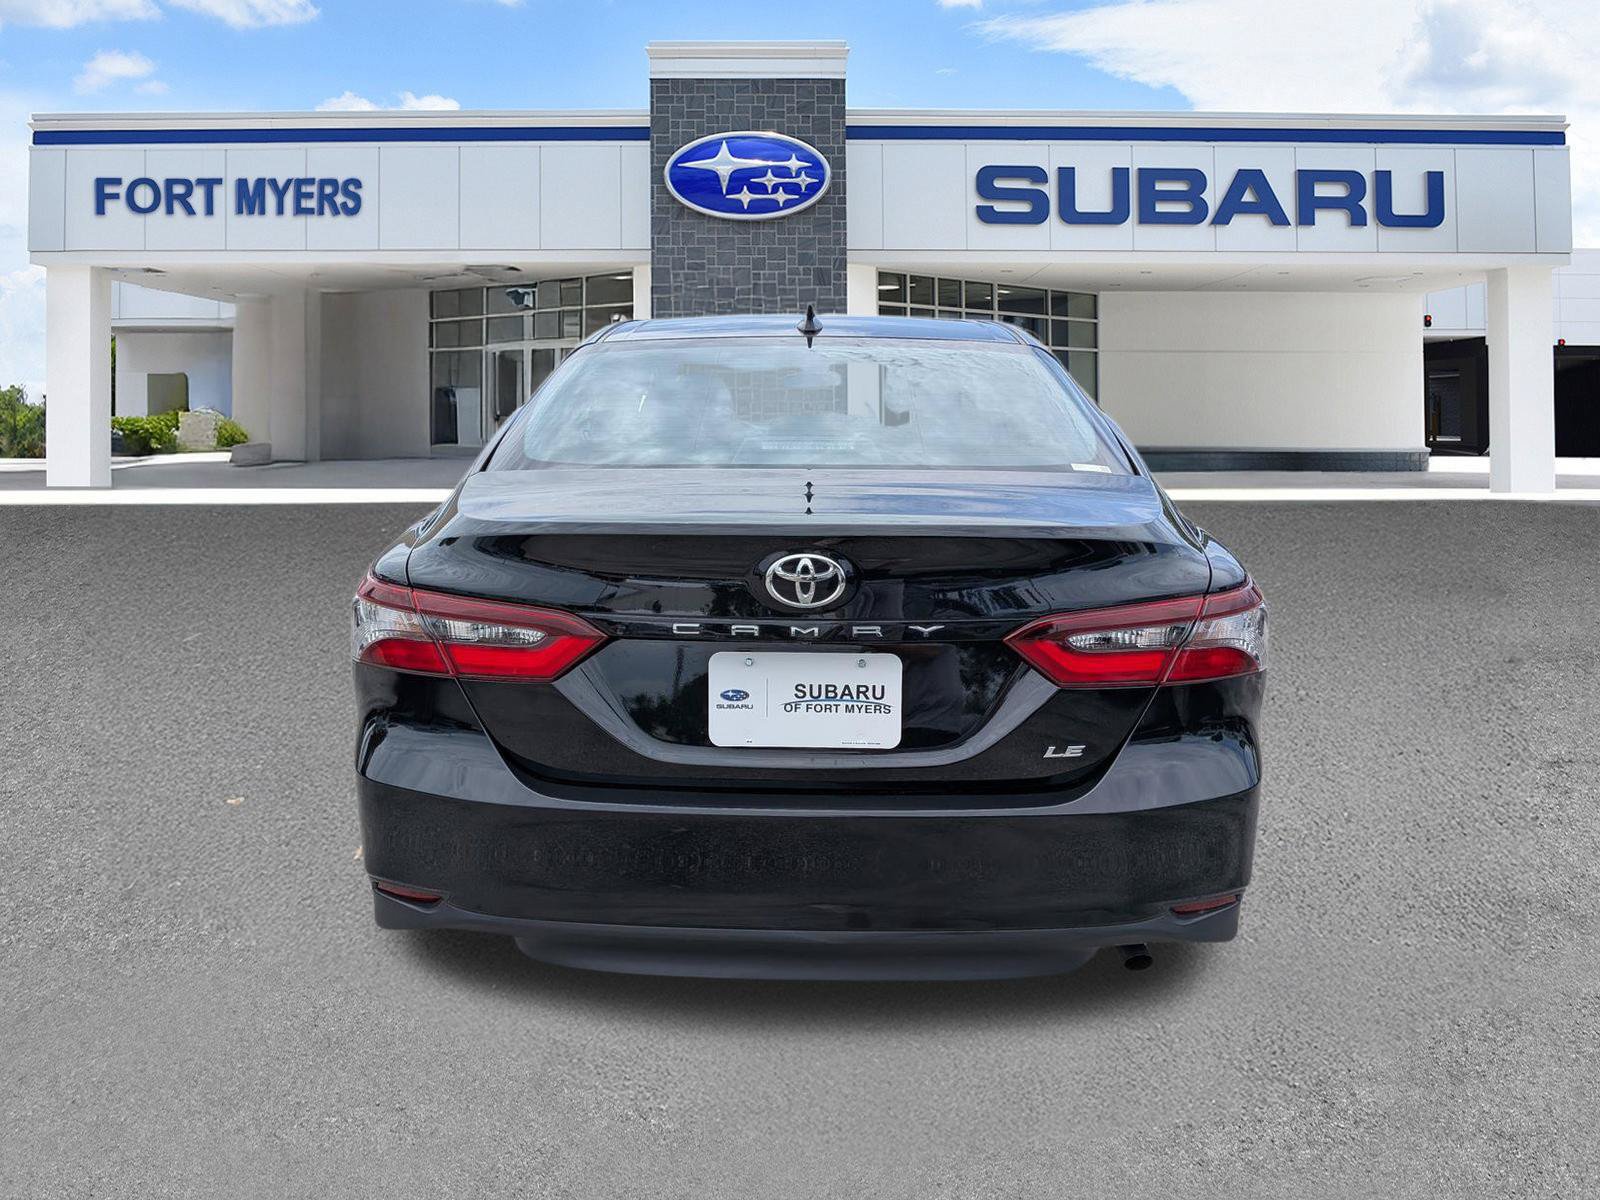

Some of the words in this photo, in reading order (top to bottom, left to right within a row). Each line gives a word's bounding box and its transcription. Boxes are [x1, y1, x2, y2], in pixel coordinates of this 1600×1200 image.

[95, 178, 223, 216] FORT
[235, 178, 363, 217] MYERS
[975, 165, 1446, 228] SUBARU
[672, 623, 945, 638] CAMRY
[794, 683, 886, 701] SUBARU
[783, 703, 801, 713] OF
[805, 703, 841, 714] FORT
[844, 704, 892, 714] MYERS
[1043, 745, 1086, 758] LE
